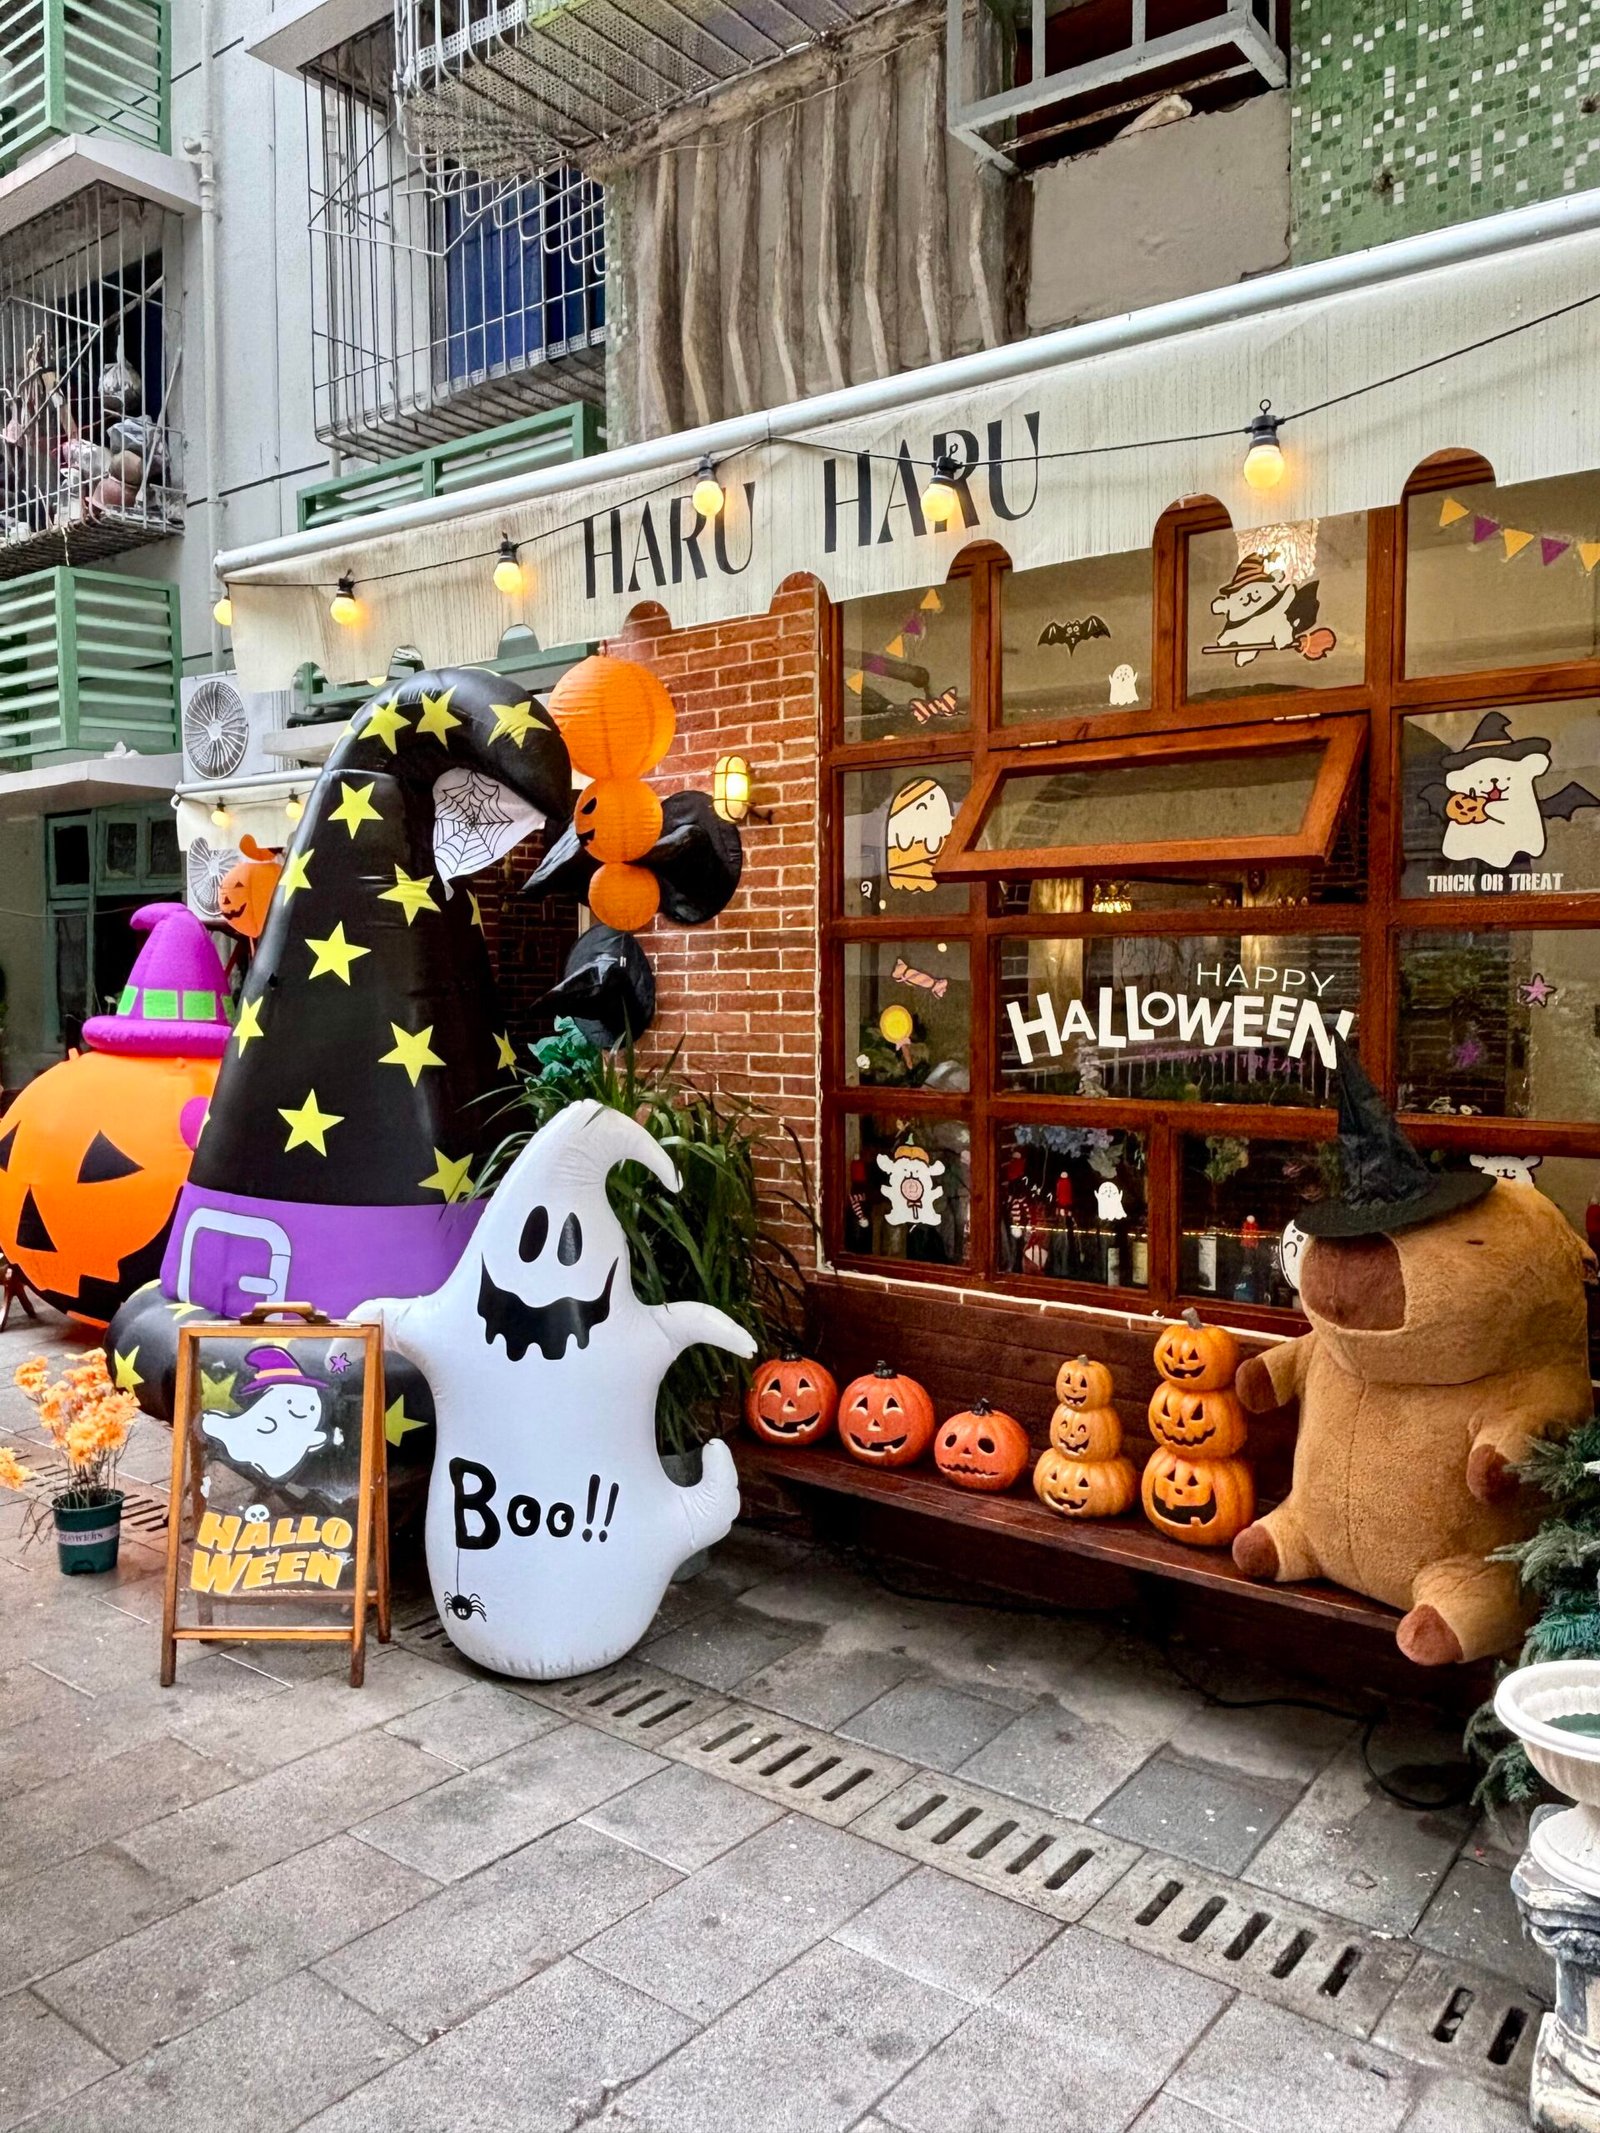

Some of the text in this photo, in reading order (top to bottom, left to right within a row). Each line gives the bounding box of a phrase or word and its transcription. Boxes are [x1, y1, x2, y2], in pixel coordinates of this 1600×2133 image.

[823, 410, 1040, 554] HARU
[1427, 872, 1563, 893] TRICK OR TREAT
[1197, 962, 1335, 997] HAPPY
[1006, 985, 1355, 1069] HALLOWEEN
[449, 1457, 619, 1550] Boo!!
[197, 1511, 353, 1551] HALLO
[191, 1549, 345, 1595] WEEN
